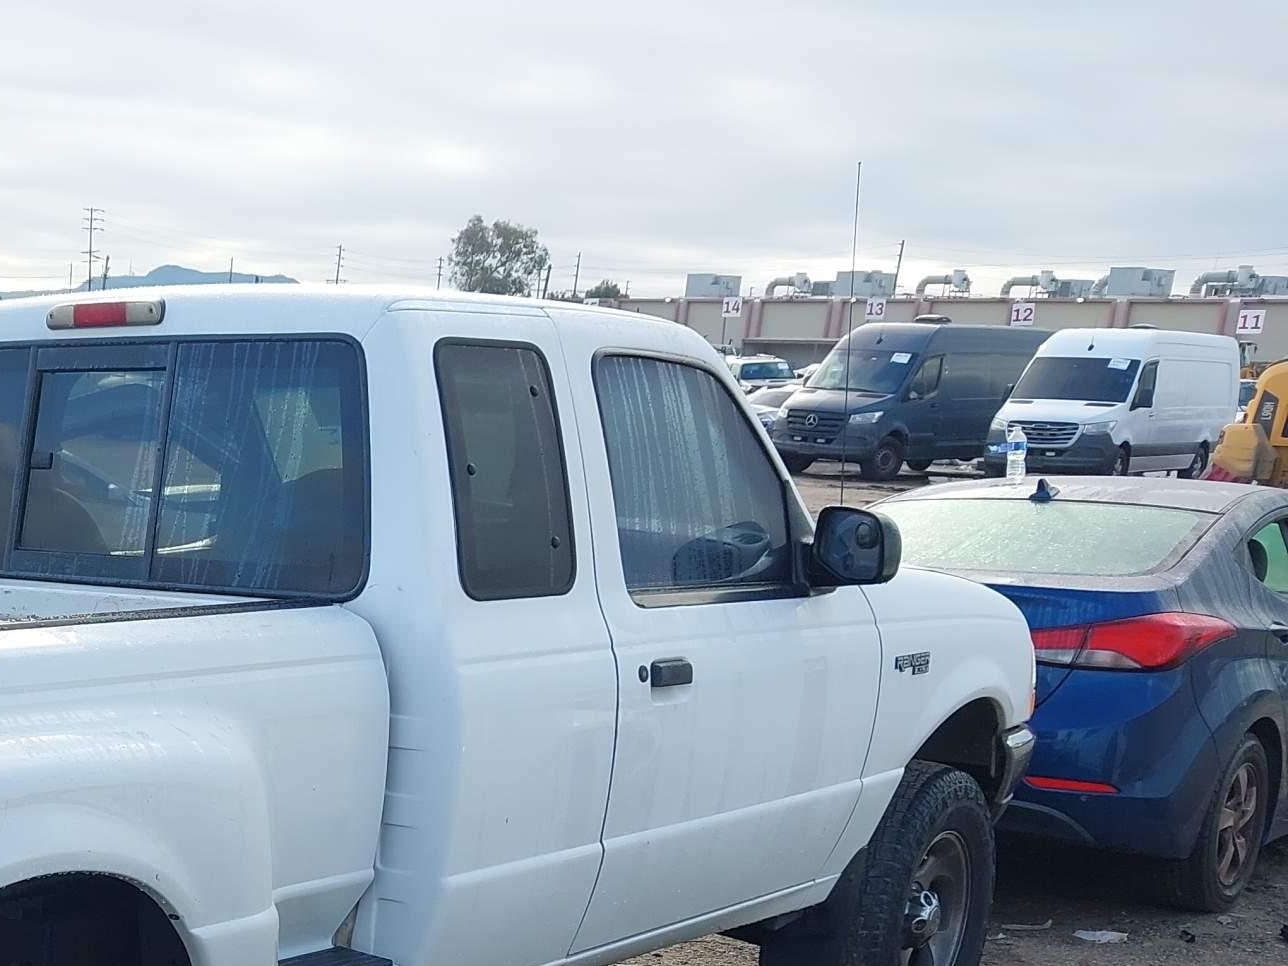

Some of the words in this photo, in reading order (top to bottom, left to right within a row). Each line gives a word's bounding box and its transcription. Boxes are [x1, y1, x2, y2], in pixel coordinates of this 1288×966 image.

[723, 300, 740, 314] 14
[866, 301, 885, 316] 13
[1012, 307, 1034, 322] 12
[1238, 314, 1261, 329] 11
